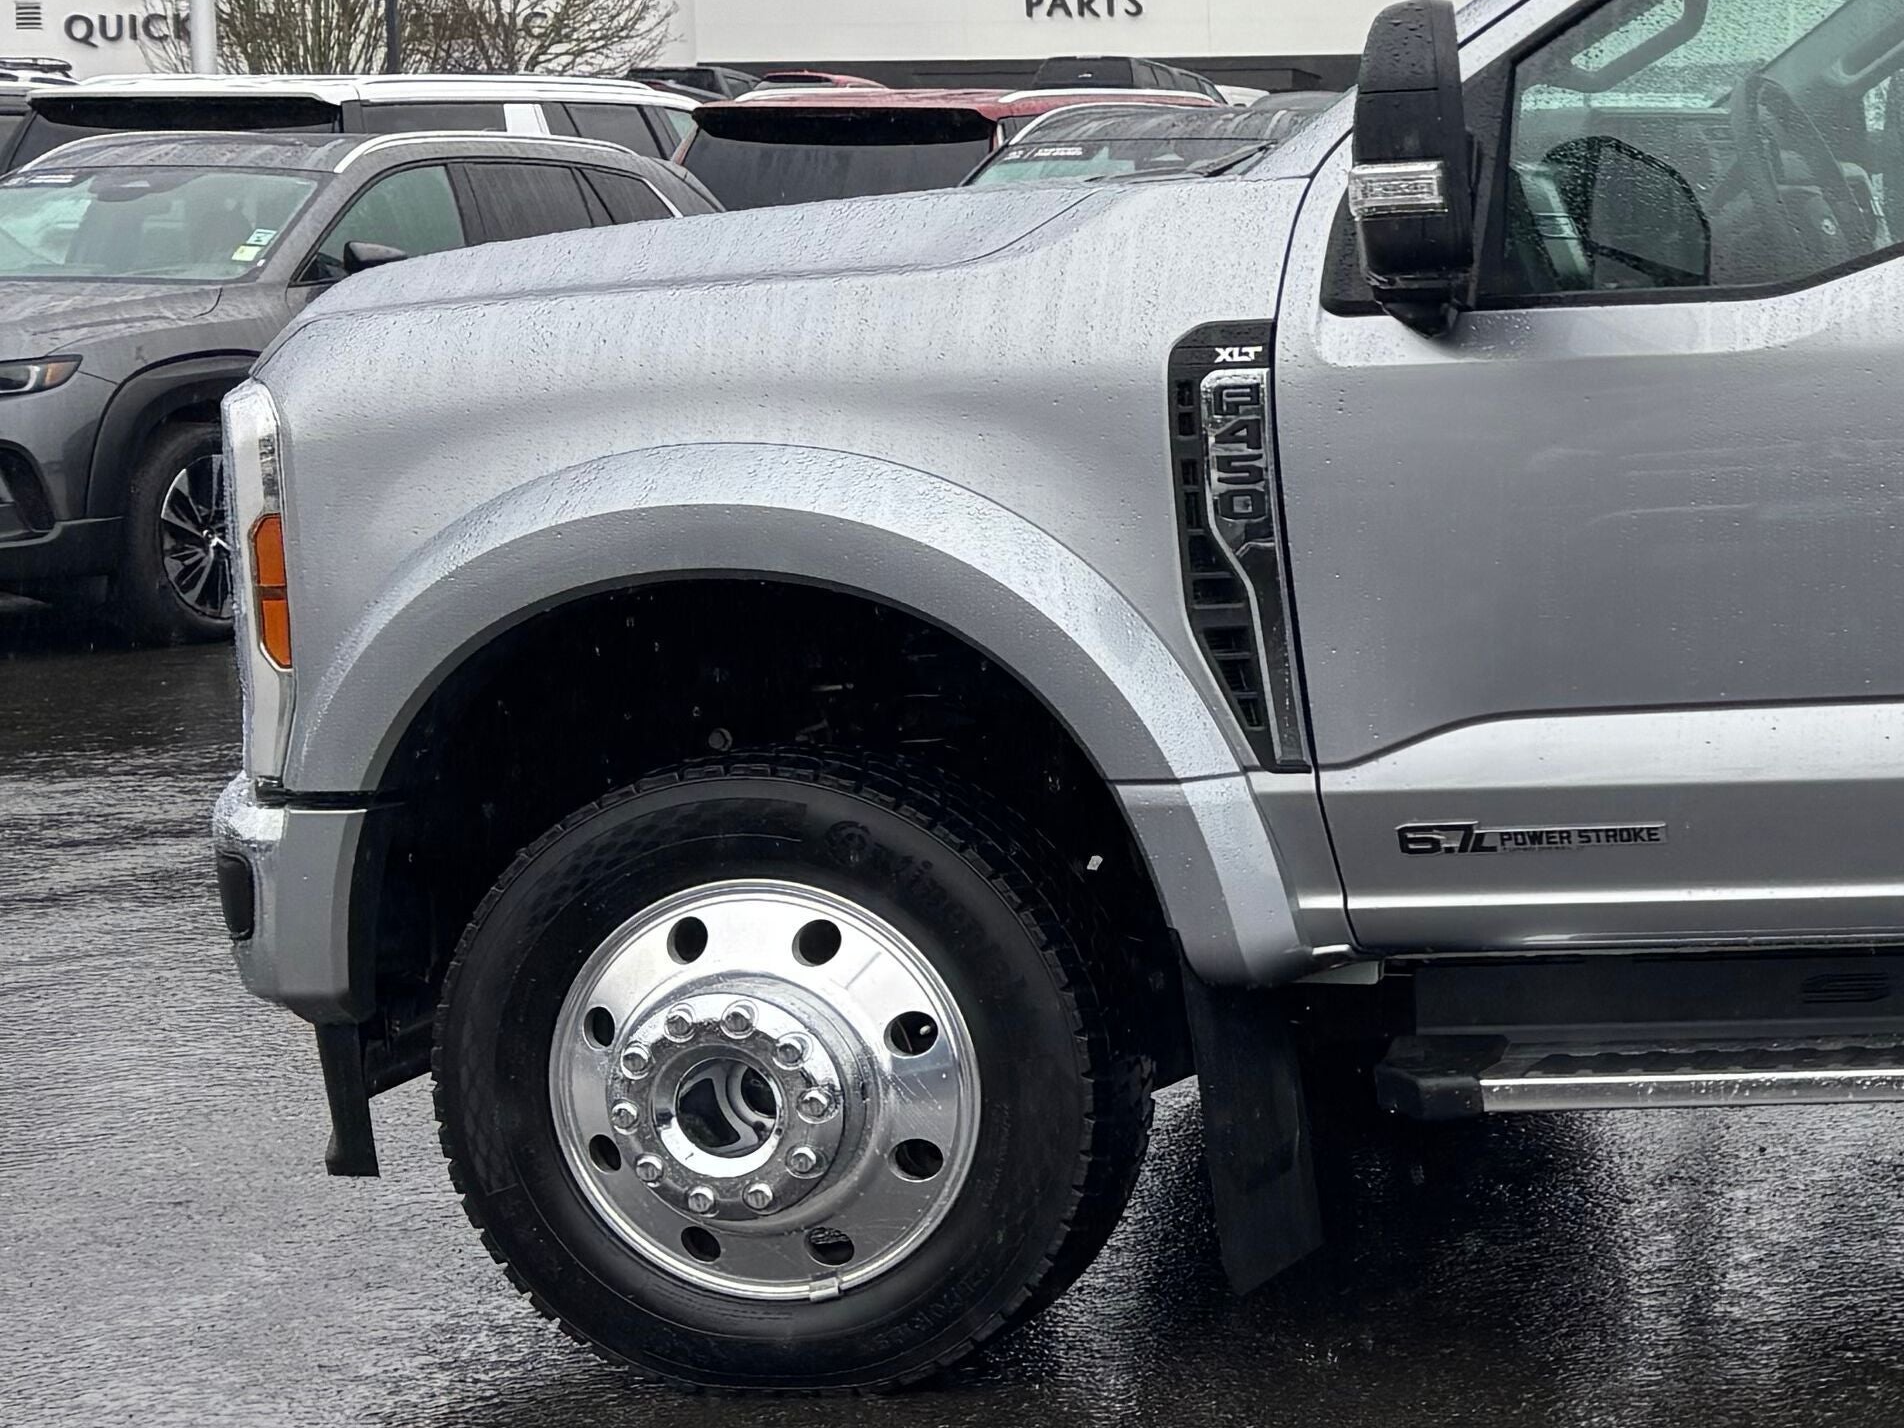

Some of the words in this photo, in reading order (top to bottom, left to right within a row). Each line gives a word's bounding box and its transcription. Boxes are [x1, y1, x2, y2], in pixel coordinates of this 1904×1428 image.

[63, 12, 191, 48] QUICK
[1213, 345, 1263, 364] XLT
[1396, 823, 1499, 856] 6.7L
[1499, 828, 1573, 847] POWER
[1578, 826, 1662, 845] STROKE
